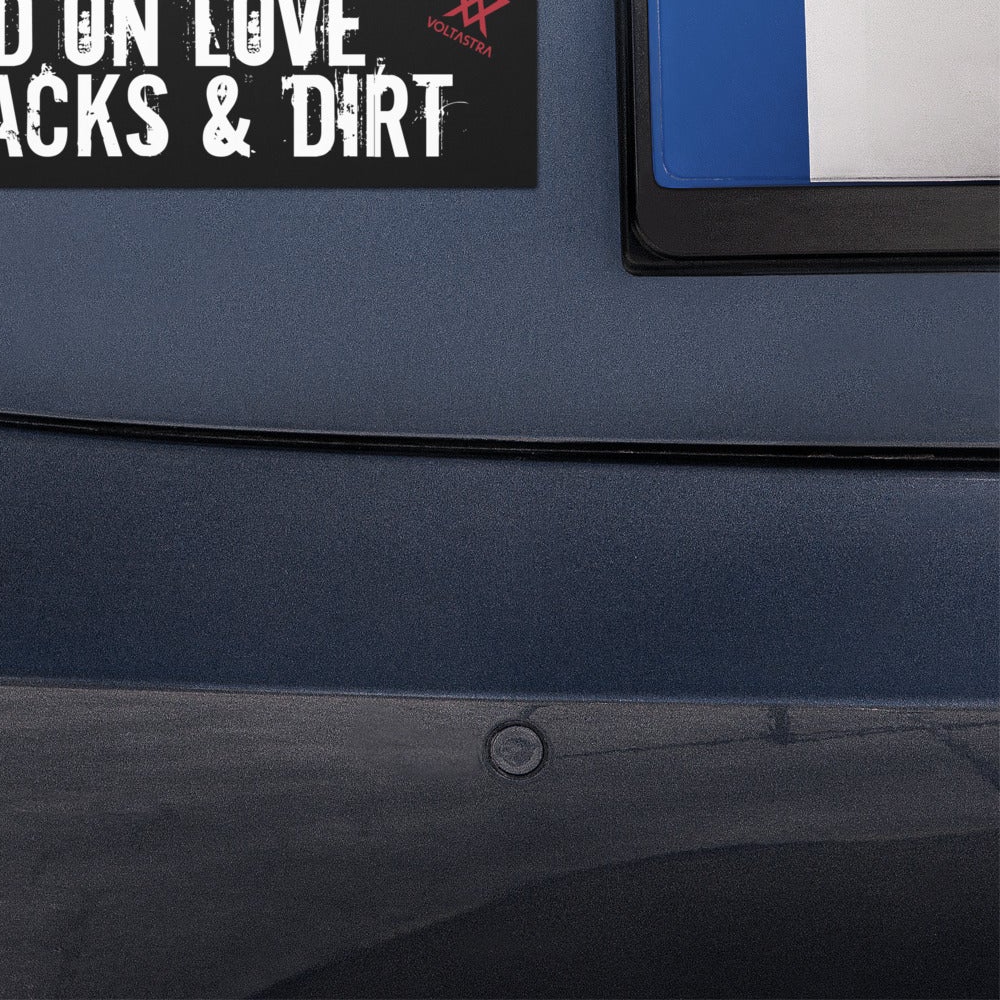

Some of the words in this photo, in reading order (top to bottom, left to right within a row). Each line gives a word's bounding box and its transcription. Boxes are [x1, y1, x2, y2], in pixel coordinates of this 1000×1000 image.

[427, 16, 493, 58] VOLTASTRA
[202, 73, 251, 158] &
[281, 72, 454, 158] DIRT
